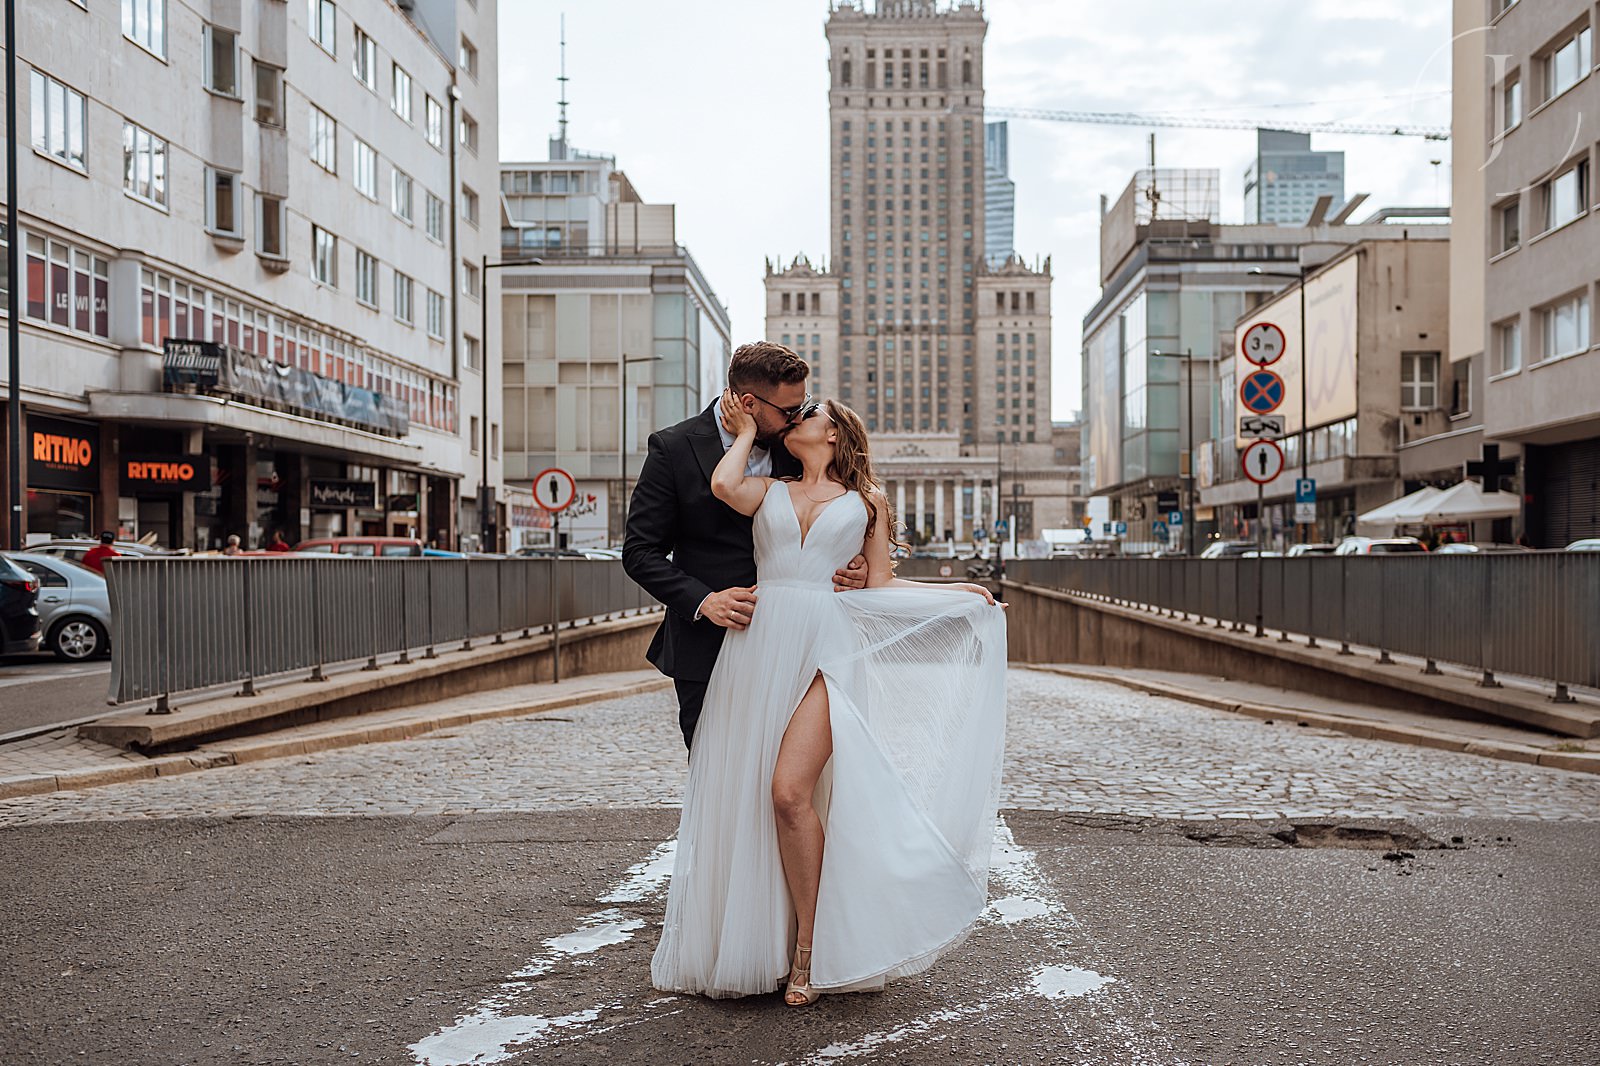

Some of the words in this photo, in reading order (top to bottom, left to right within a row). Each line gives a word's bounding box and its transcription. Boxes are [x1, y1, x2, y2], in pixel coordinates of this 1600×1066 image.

[1251, 336, 1260, 351] 3
[1263, 343, 1275, 351] m
[33, 431, 92, 467] RITMO
[127, 461, 195, 481] RITMO
[1300, 481, 1313, 497] P
[1171, 512, 1181, 525] P
